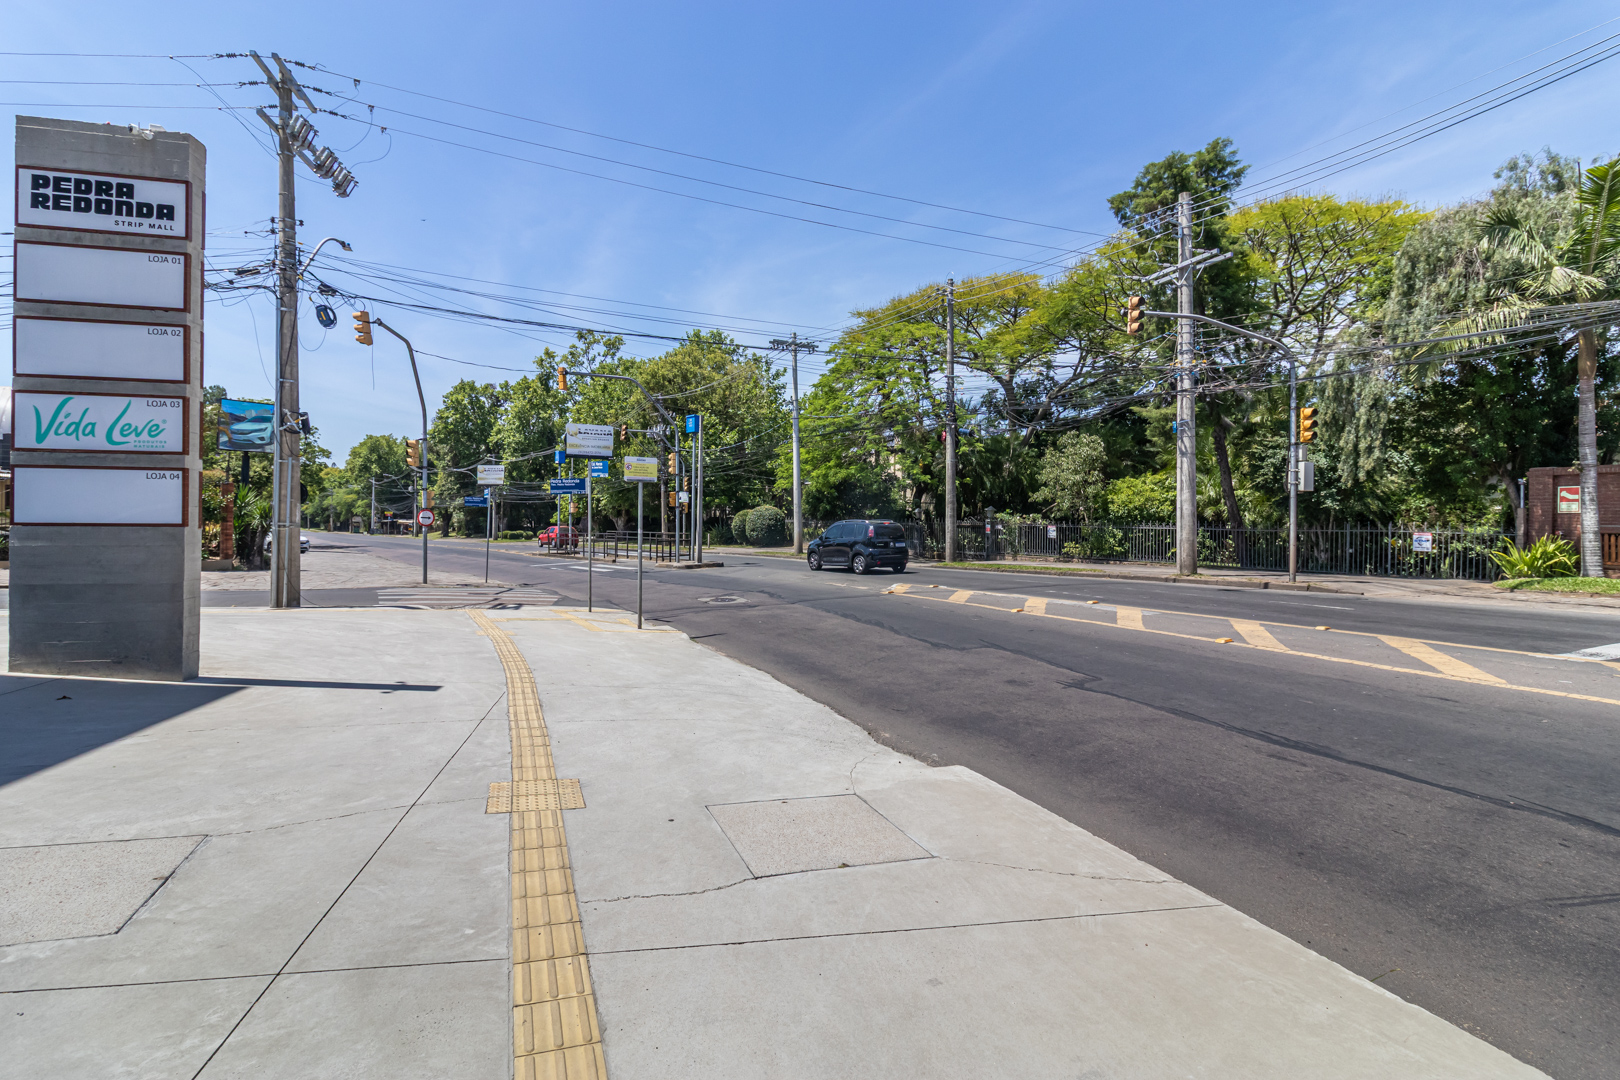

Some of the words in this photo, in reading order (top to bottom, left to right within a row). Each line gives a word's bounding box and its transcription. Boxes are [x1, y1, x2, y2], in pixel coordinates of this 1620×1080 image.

[31, 174, 134, 200] PEDRA
[30, 192, 175, 221] REDONDA
[114, 220, 144, 228] STRIP
[148, 222, 175, 231] MALL
[148, 255, 170, 263] LOJA
[147, 328, 169, 336] LOJA
[170, 329, 181, 337] 02
[146, 400, 168, 408] LOJA
[32, 396, 96, 445] Vida
[105, 399, 167, 446] Leve
[146, 472, 167, 480] LOJA
[169, 473, 180, 481] 04
